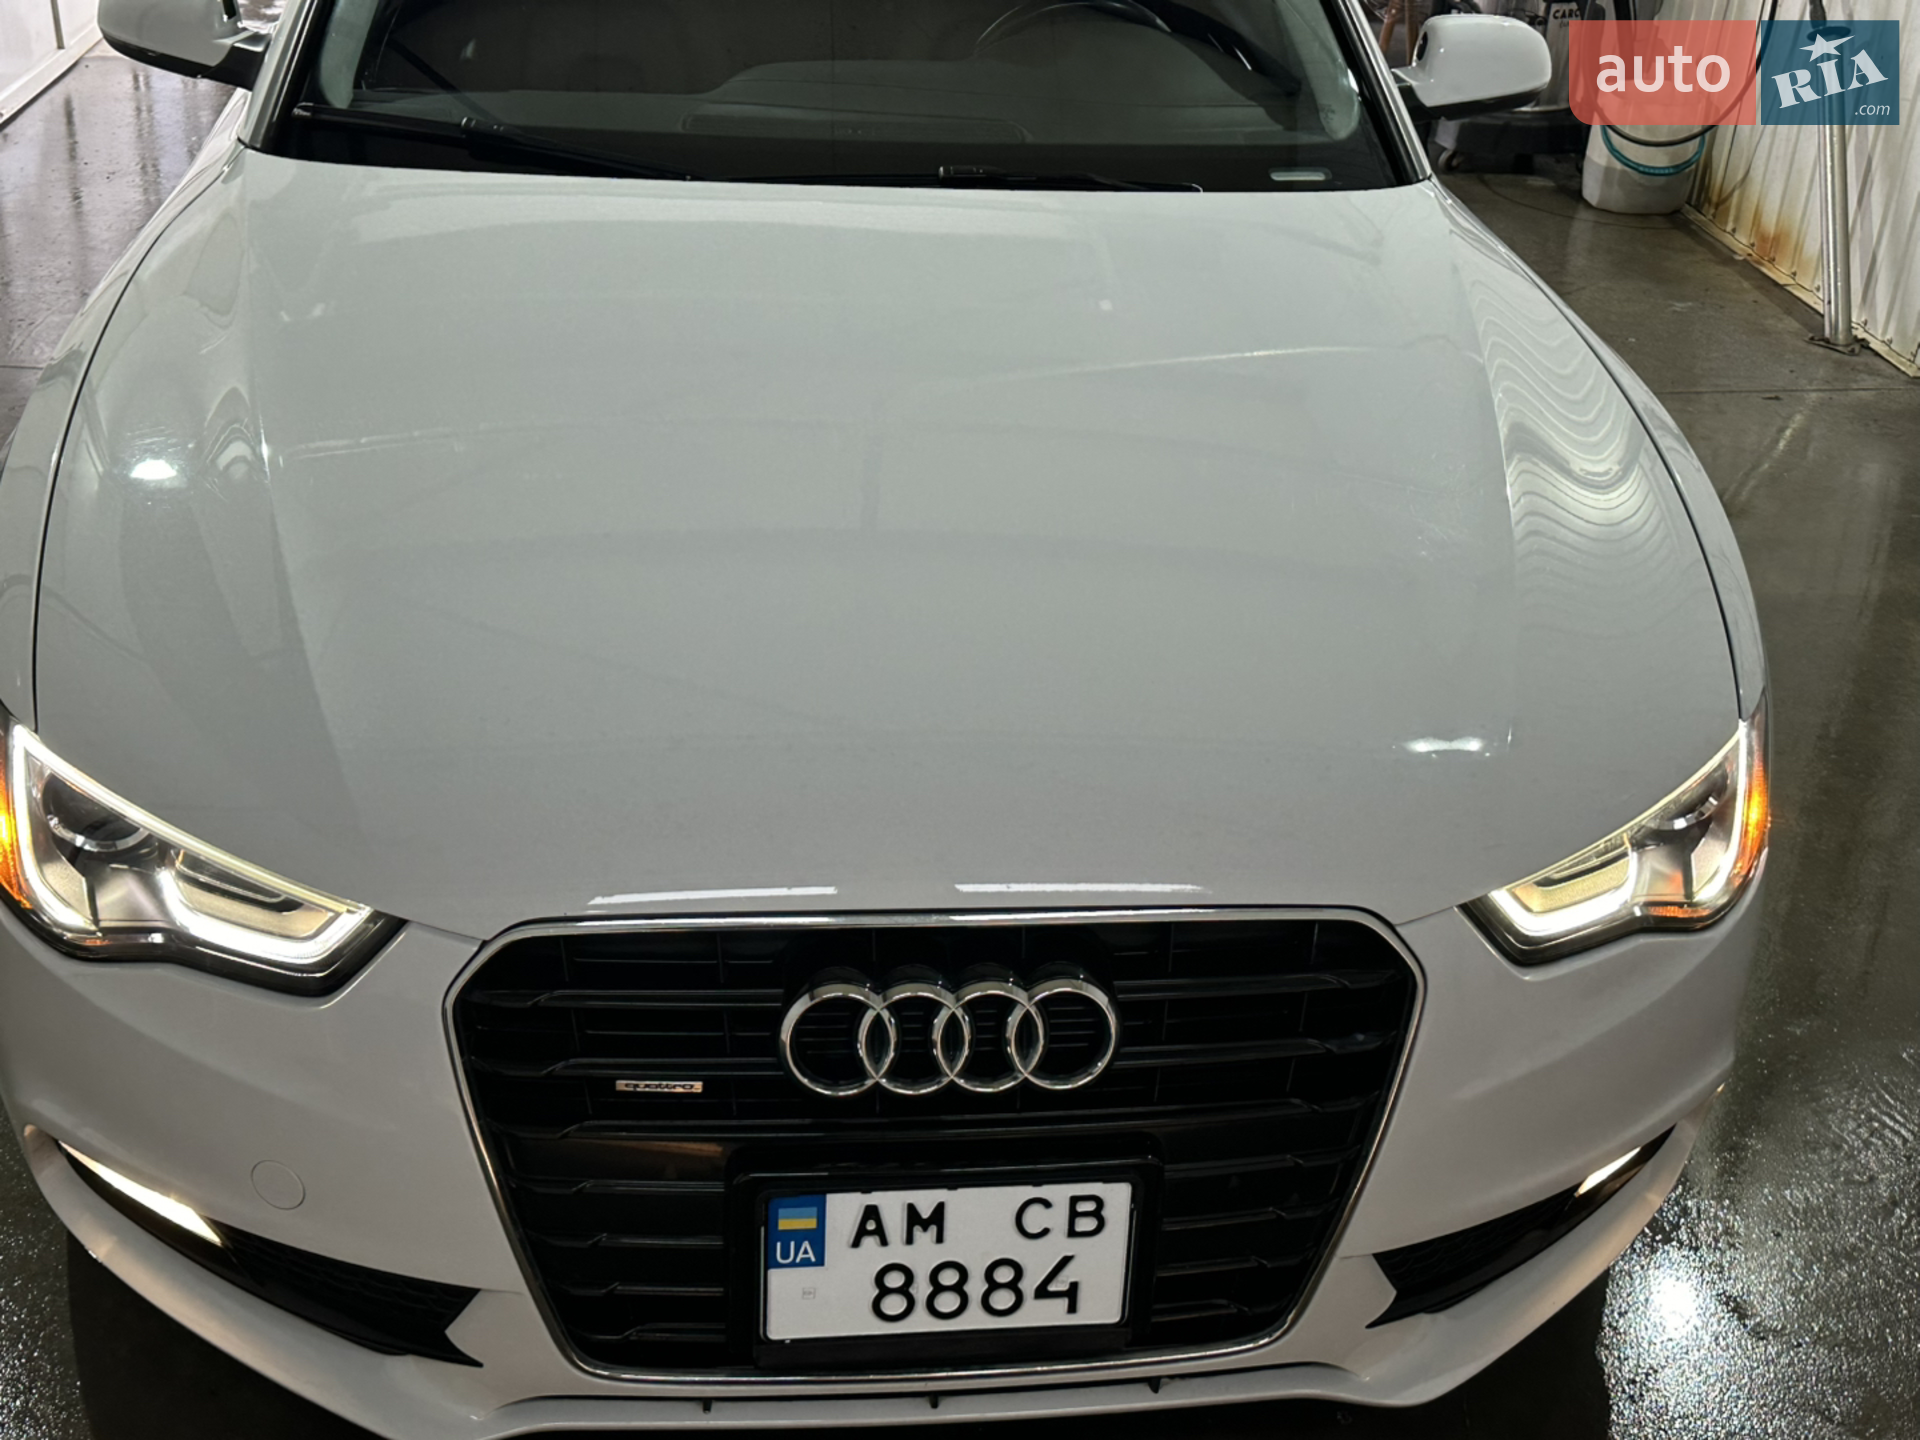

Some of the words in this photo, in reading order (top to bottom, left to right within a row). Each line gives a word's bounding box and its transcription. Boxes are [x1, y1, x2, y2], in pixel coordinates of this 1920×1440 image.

[624, 1082, 695, 1092] quattro
[849, 1201, 945, 1248] AM
[1014, 1194, 1105, 1239] CB
[776, 1240, 816, 1264] UA
[872, 1255, 1078, 1322] 8884
